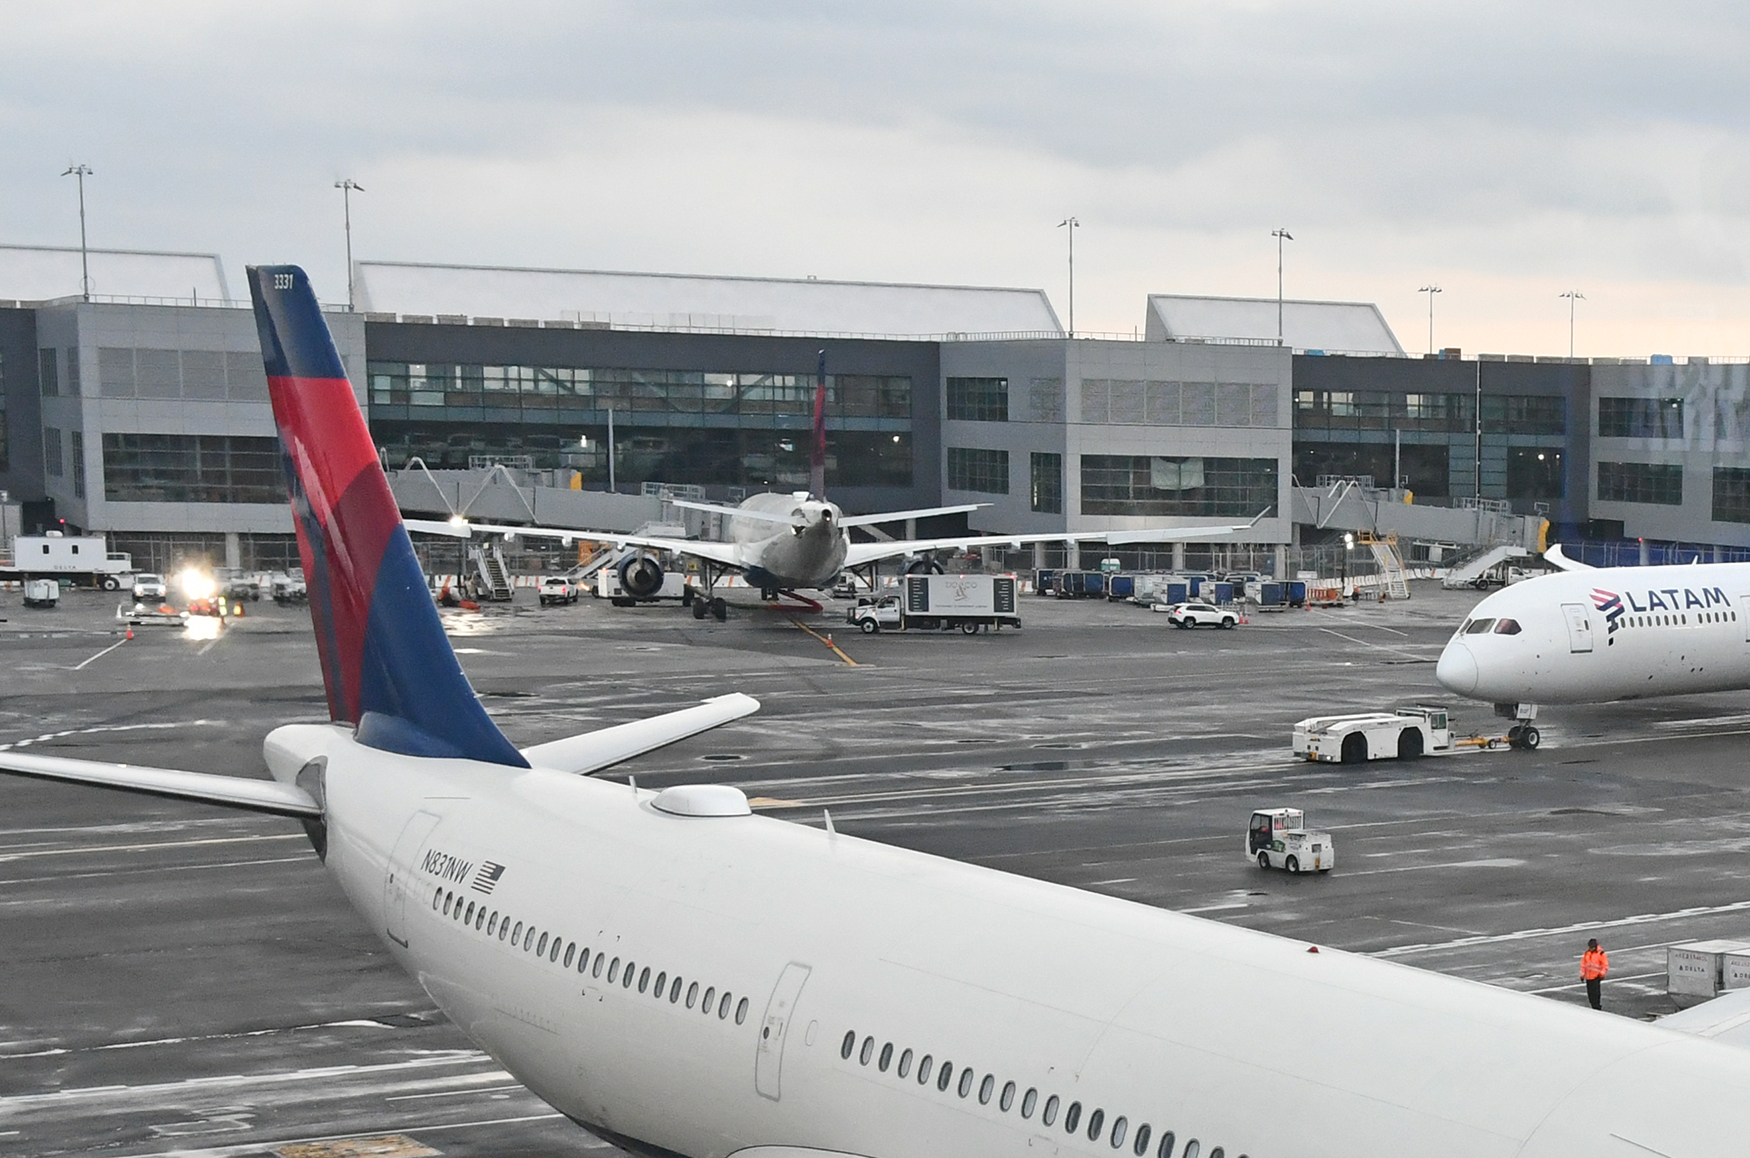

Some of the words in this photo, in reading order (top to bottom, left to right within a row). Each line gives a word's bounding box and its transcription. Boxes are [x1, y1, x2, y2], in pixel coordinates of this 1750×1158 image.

[274, 273, 294, 290] 3331
[1624, 587, 1732, 613] LATAM
[420, 848, 474, 885] N831NW
[1684, 965, 1705, 973] DELTA
